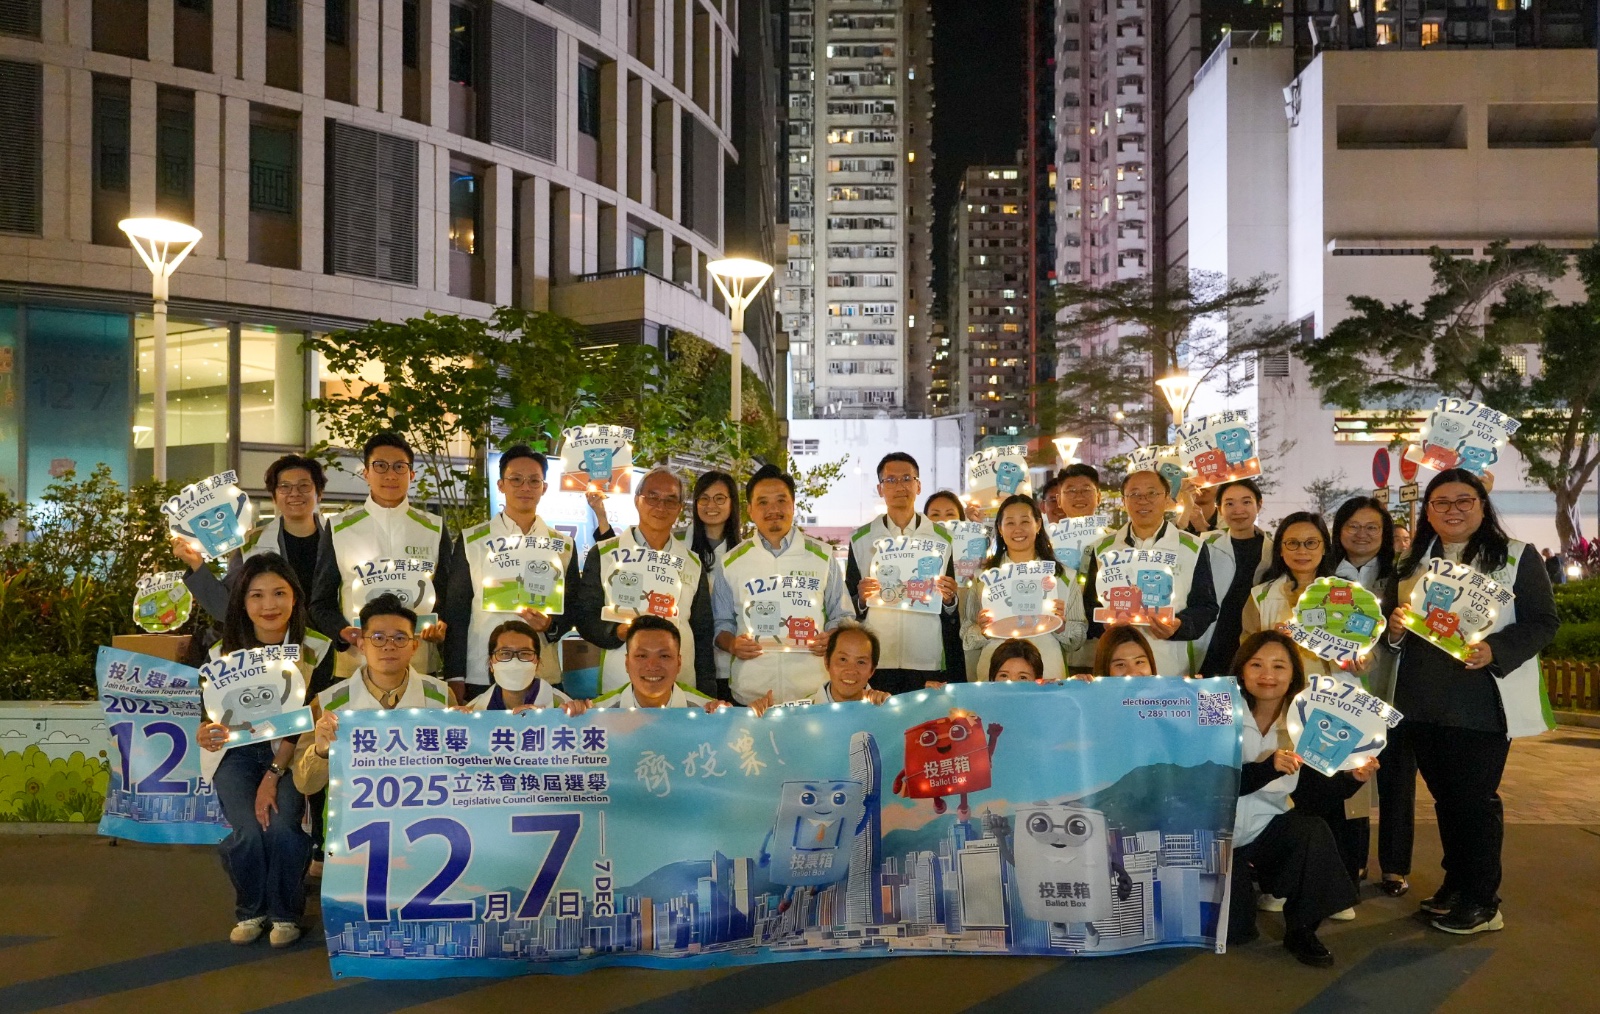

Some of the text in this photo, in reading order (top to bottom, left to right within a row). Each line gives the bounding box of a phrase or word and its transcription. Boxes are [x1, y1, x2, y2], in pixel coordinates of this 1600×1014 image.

[1439, 398, 1521, 434] 12.7 齊投票
[1176, 416, 1207, 440] 12.7
[1471, 420, 1494, 433] LET'S
[570, 439, 589, 448] LET'S
[1477, 430, 1497, 445] VOTE
[1128, 446, 1158, 464] 12.7
[1184, 441, 1203, 455] VOTE
[973, 468, 989, 479] VOTE
[162, 486, 196, 516] 12.7
[174, 492, 216, 521] LET'S VOTE
[1049, 519, 1070, 537] 2.7
[1059, 531, 1078, 541] LET'S
[486, 535, 523, 553] 12.7
[498, 559, 521, 568] VOTE
[611, 548, 684, 569] 12.7 齊投票
[881, 553, 898, 561] LET'S
[1100, 549, 1177, 568] 12.7 齊投票
[353, 558, 391, 578] 12.7
[647, 564, 667, 574] LET'S
[1431, 559, 1472, 581] 12.7
[157, 582, 173, 590] VOTE
[361, 572, 407, 586] LET'S VOTE
[655, 573, 674, 585] VOTE
[744, 575, 821, 596] 12.7 齊投票
[1102, 573, 1124, 583] VOTE
[791, 599, 812, 608] VOTE
[987, 589, 1008, 603] VOTE
[1467, 589, 1490, 606] LET'S
[1470, 600, 1491, 618] VOTE
[1312, 628, 1360, 650] LET'S VOTE
[201, 645, 299, 682] 12.7 齊投票
[213, 665, 268, 690] LET'S VOTE
[104, 681, 118, 689] Join
[119, 683, 130, 692] the
[130, 686, 160, 695] Election
[160, 689, 194, 697] Together
[103, 694, 169, 715] 2025
[1122, 698, 1191, 707] elections.gov.hk
[1309, 675, 1402, 727] 12.7 齊投票
[1310, 692, 1363, 718] LET'S VOTE
[1147, 710, 1191, 718] 2891 1001
[352, 726, 607, 753] 投入選舉 共創未來
[351, 754, 607, 768] Join the Election Together We Create the Future
[923, 756, 971, 779] 投票箱
[351, 772, 607, 809] 2025 立法會換屆選舉
[929, 775, 967, 788] Ballot Box
[453, 794, 608, 807] Legislative Council General Election
[790, 852, 834, 870] 投票箱
[594, 861, 612, 916] 7 DEC
[1038, 881, 1091, 899] 投票箱
[1045, 899, 1069, 907] Ballot
